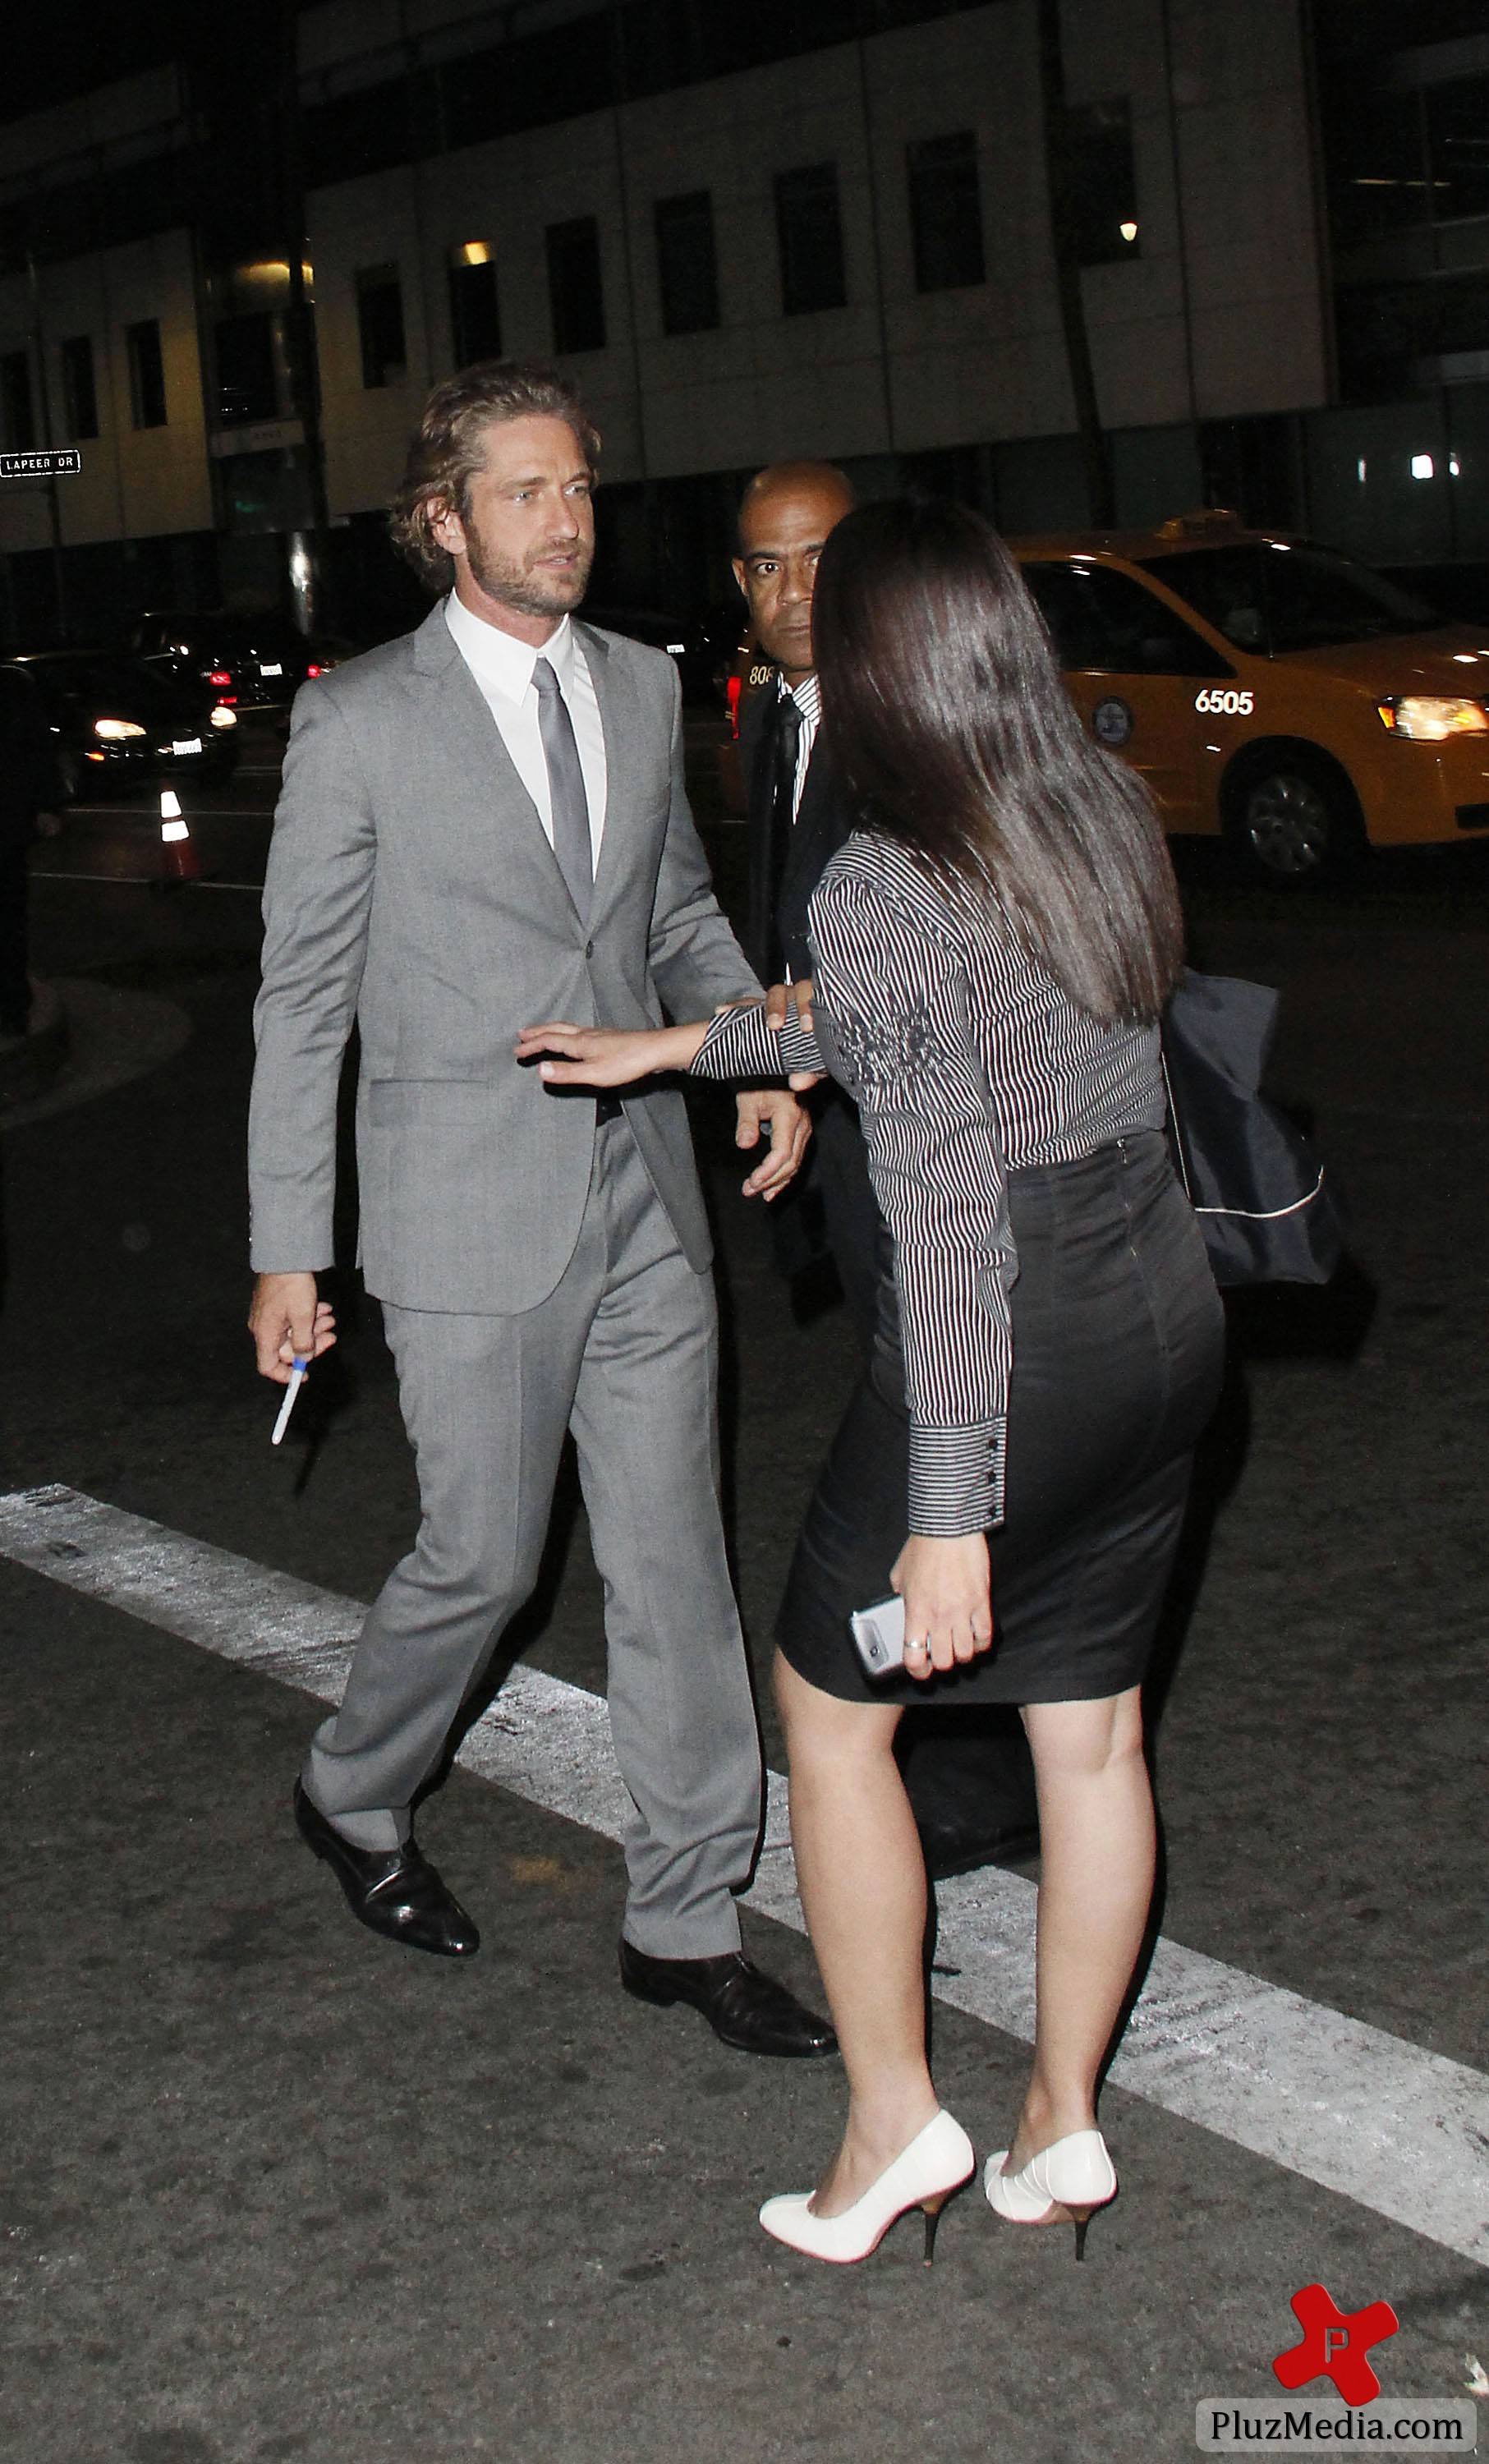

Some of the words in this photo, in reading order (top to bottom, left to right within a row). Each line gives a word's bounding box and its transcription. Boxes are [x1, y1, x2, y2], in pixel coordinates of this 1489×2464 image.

[6, 458, 50, 471] LAPEER
[58, 457, 73, 467] DR
[1195, 689, 1254, 715] 6505
